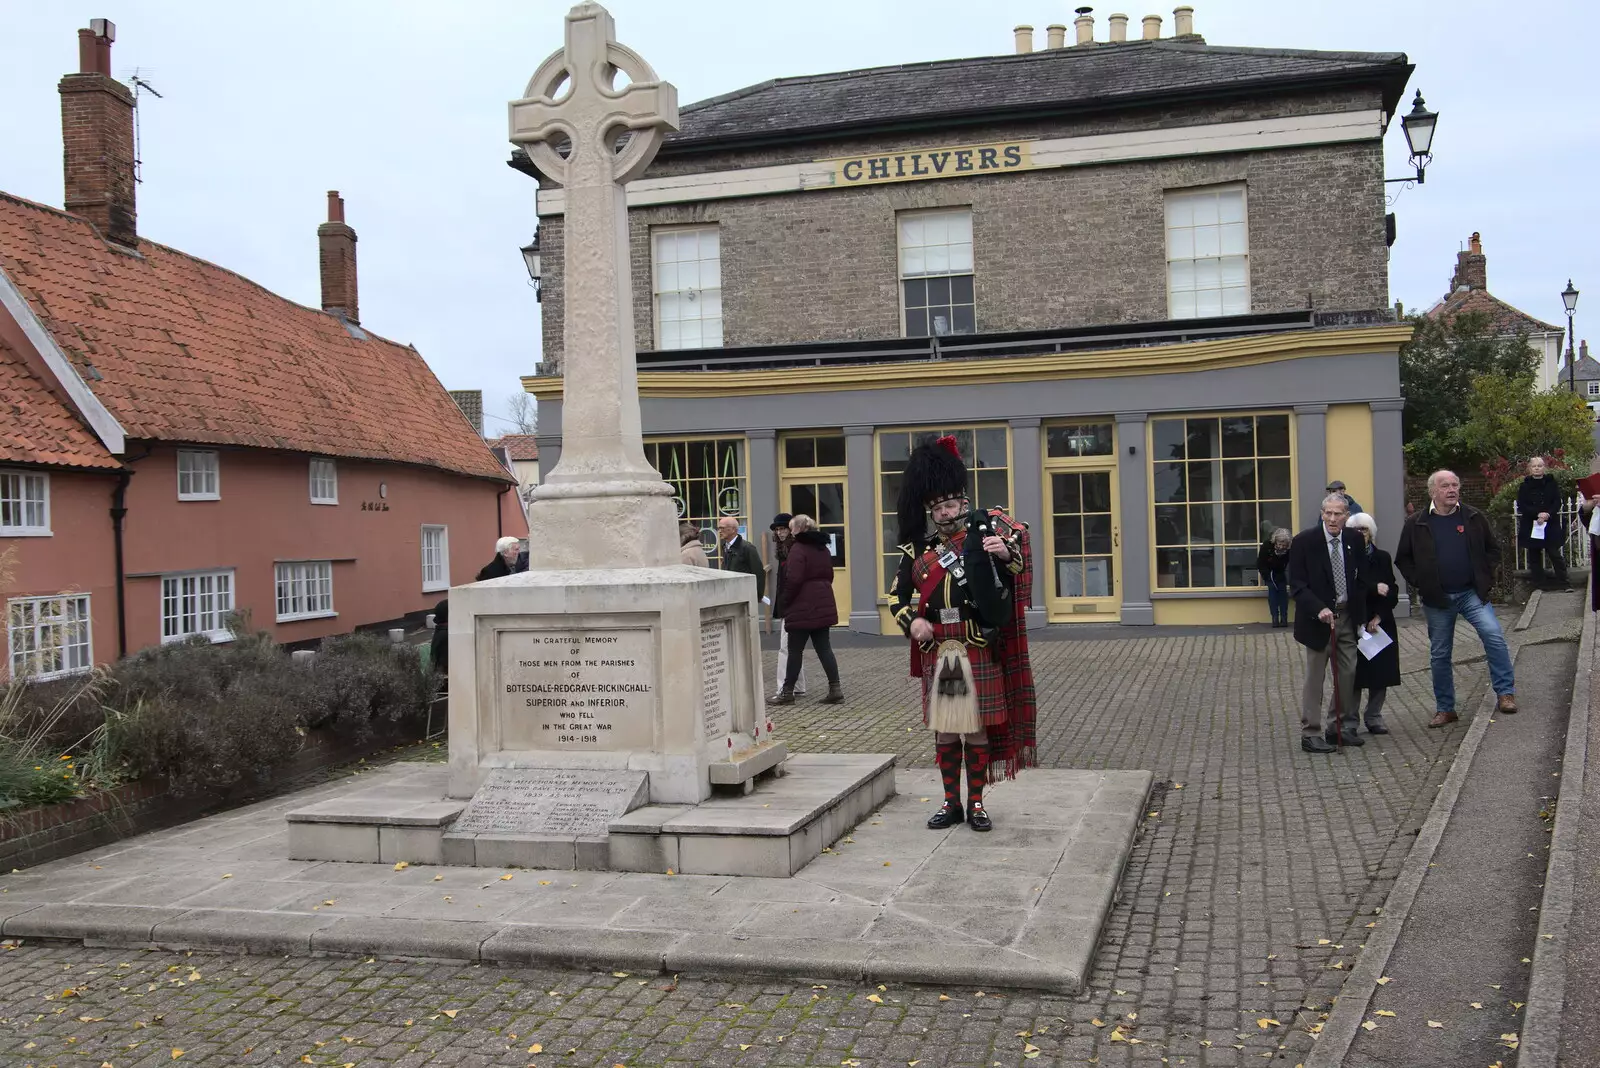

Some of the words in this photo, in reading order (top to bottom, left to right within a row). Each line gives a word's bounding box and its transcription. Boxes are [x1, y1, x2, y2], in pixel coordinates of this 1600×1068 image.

[843, 145, 1022, 181] CHILVERS
[532, 637, 541, 645] IN
[543, 637, 581, 645] GRATEFUL
[584, 636, 618, 644] MEMORY
[570, 648, 580, 656] OF
[519, 660, 541, 668] THOSE
[561, 659, 581, 667] FROM
[585, 659, 598, 667] THE
[600, 659, 635, 667] PARISHES
[570, 671, 580, 679] OF
[526, 698, 567, 707] SUPERIOR
[570, 700, 585, 708] AND
[560, 711, 576, 719] WHO
[579, 711, 595, 719] FELL
[542, 723, 550, 731] IN
[553, 723, 566, 731] THE
[569, 723, 593, 731] GREAT
[596, 723, 612, 731] WAR
